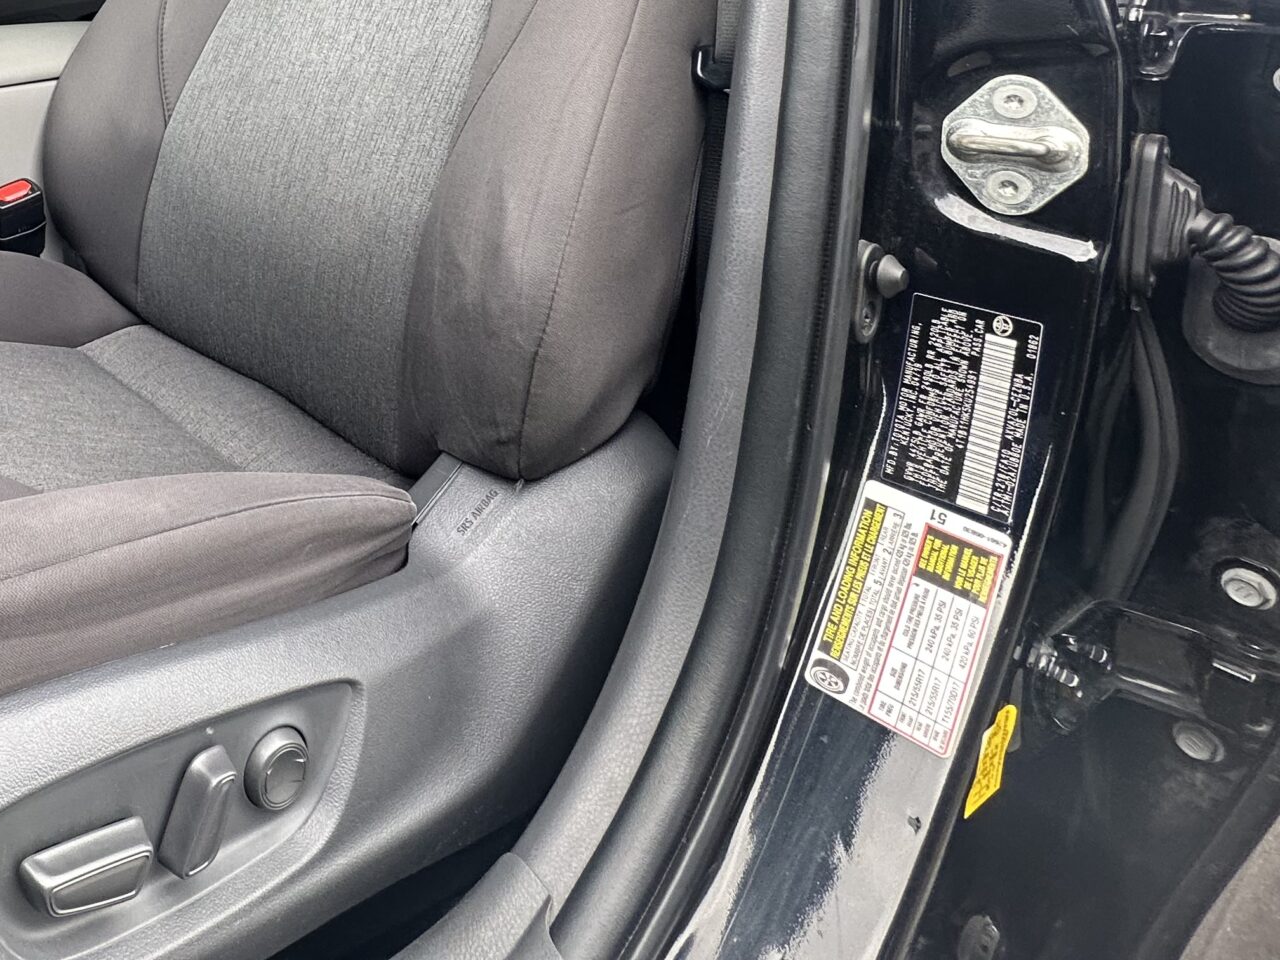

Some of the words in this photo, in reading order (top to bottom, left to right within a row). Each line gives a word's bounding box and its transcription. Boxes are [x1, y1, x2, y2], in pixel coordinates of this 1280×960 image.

[897, 386, 909, 411] MOTOR
[457, 517, 474, 536] SRS
[471, 489, 499, 520] AIRBAG
[892, 511, 903, 520] 3
[865, 502, 886, 545] CHARGEMENT
[847, 507, 873, 567] INFORMATION
[862, 542, 874, 553] LE
[882, 547, 892, 555] 2
[860, 550, 872, 562] ET
[854, 558, 869, 582] PNEUS
[835, 563, 856, 605] LOADING
[850, 578, 863, 593] LES
[872, 578, 882, 586] 5
[846, 590, 859, 607] SUR
[935, 598, 947, 614] PSI
[828, 601, 844, 624] AND
[933, 611, 943, 623] 35
[952, 606, 964, 622] PSI
[949, 619, 959, 631] 35
[969, 614, 981, 630] PSI
[822, 620, 838, 644] TIRE
[829, 602, 855, 660] RENSEIGNEMENTS
[966, 628, 976, 639] 60
[924, 637, 935, 653] 240
[940, 646, 952, 662] 240
[957, 654, 968, 670] 420
[907, 667, 926, 707] 215/55R17
[924, 675, 942, 716] 215/55R17
[941, 679, 961, 724] T155/70D17
